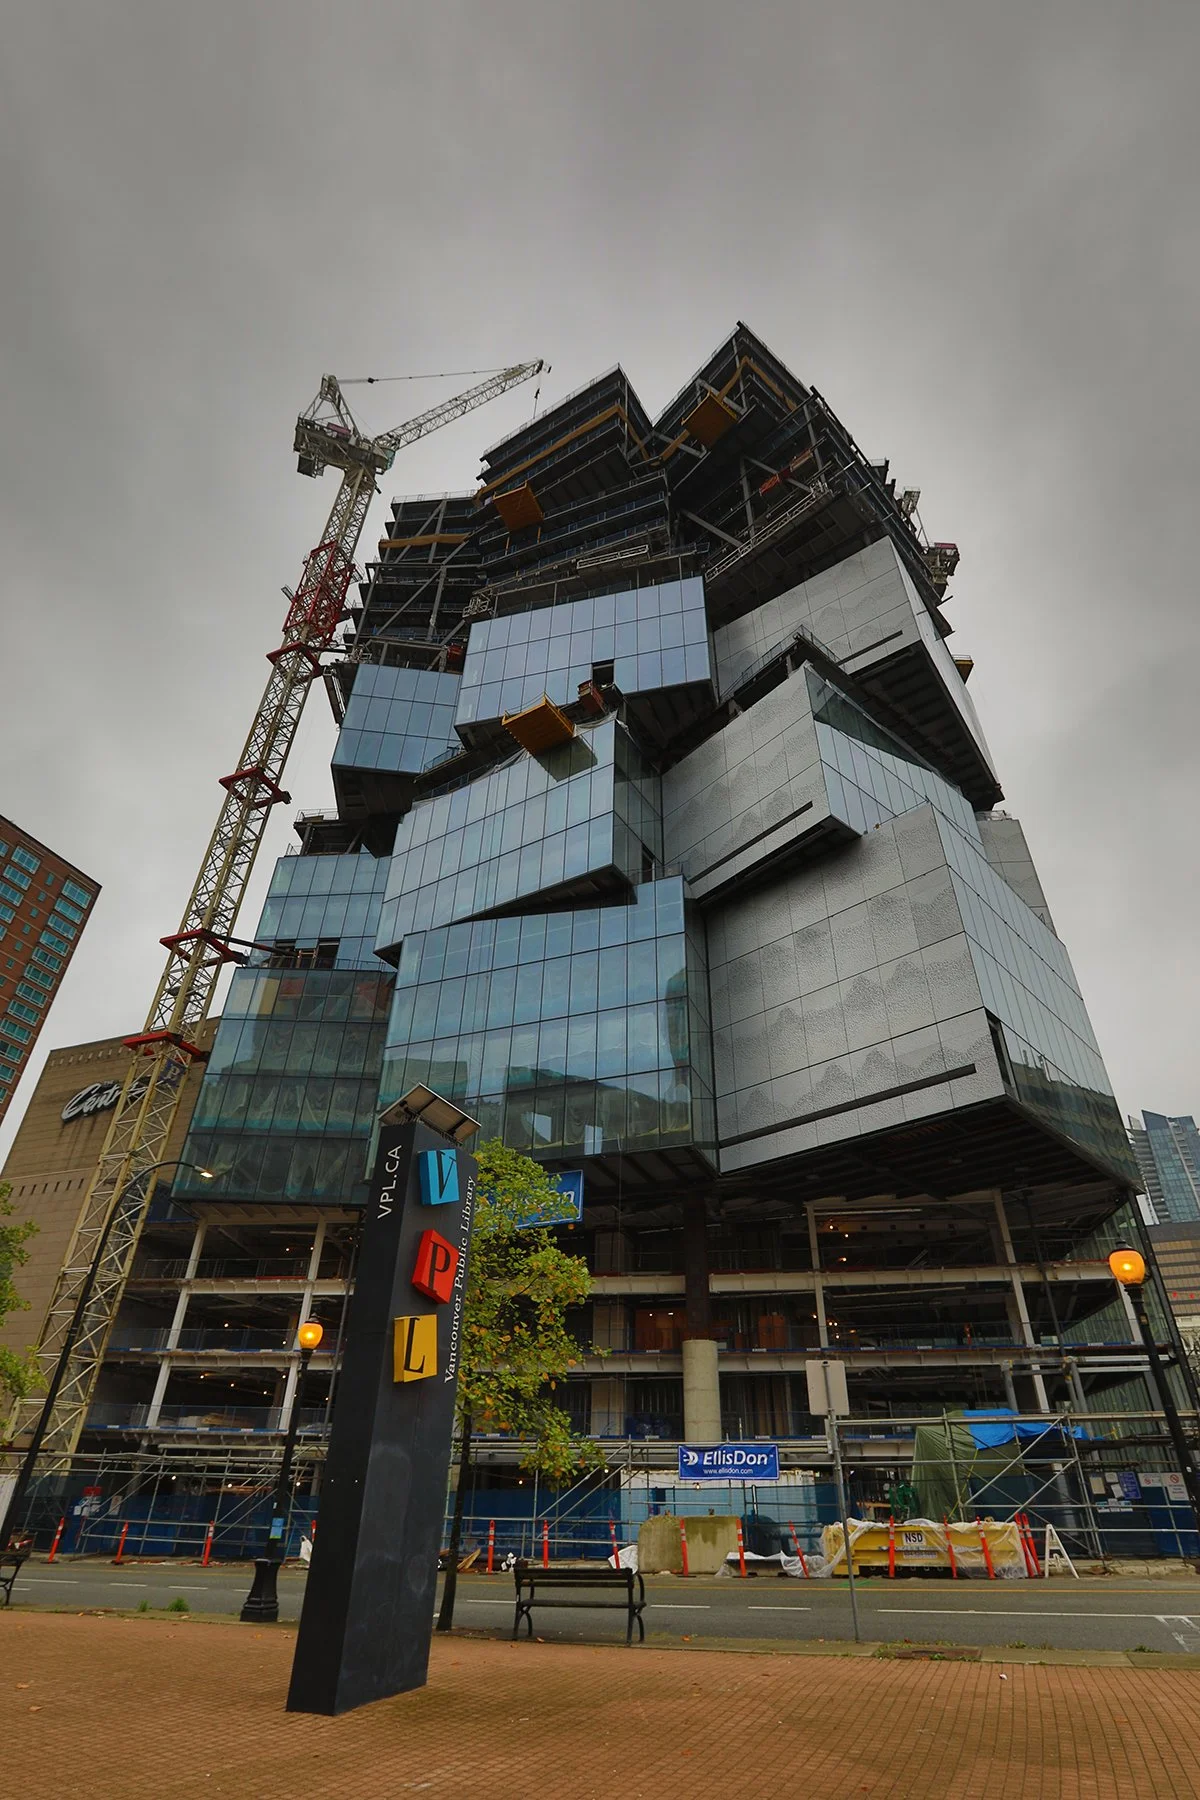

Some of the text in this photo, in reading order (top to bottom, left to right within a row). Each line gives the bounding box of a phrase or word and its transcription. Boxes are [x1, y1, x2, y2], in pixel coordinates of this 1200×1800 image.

[377, 1145, 402, 1219] VPL.CA
[403, 1150, 457, 1374] V P L
[444, 1176, 476, 1383] Vancouver Public Library
[703, 1450, 768, 1465] EllisDon
[703, 1467, 753, 1475] www.ellisdon.com
[905, 1532, 923, 1543] NSD
